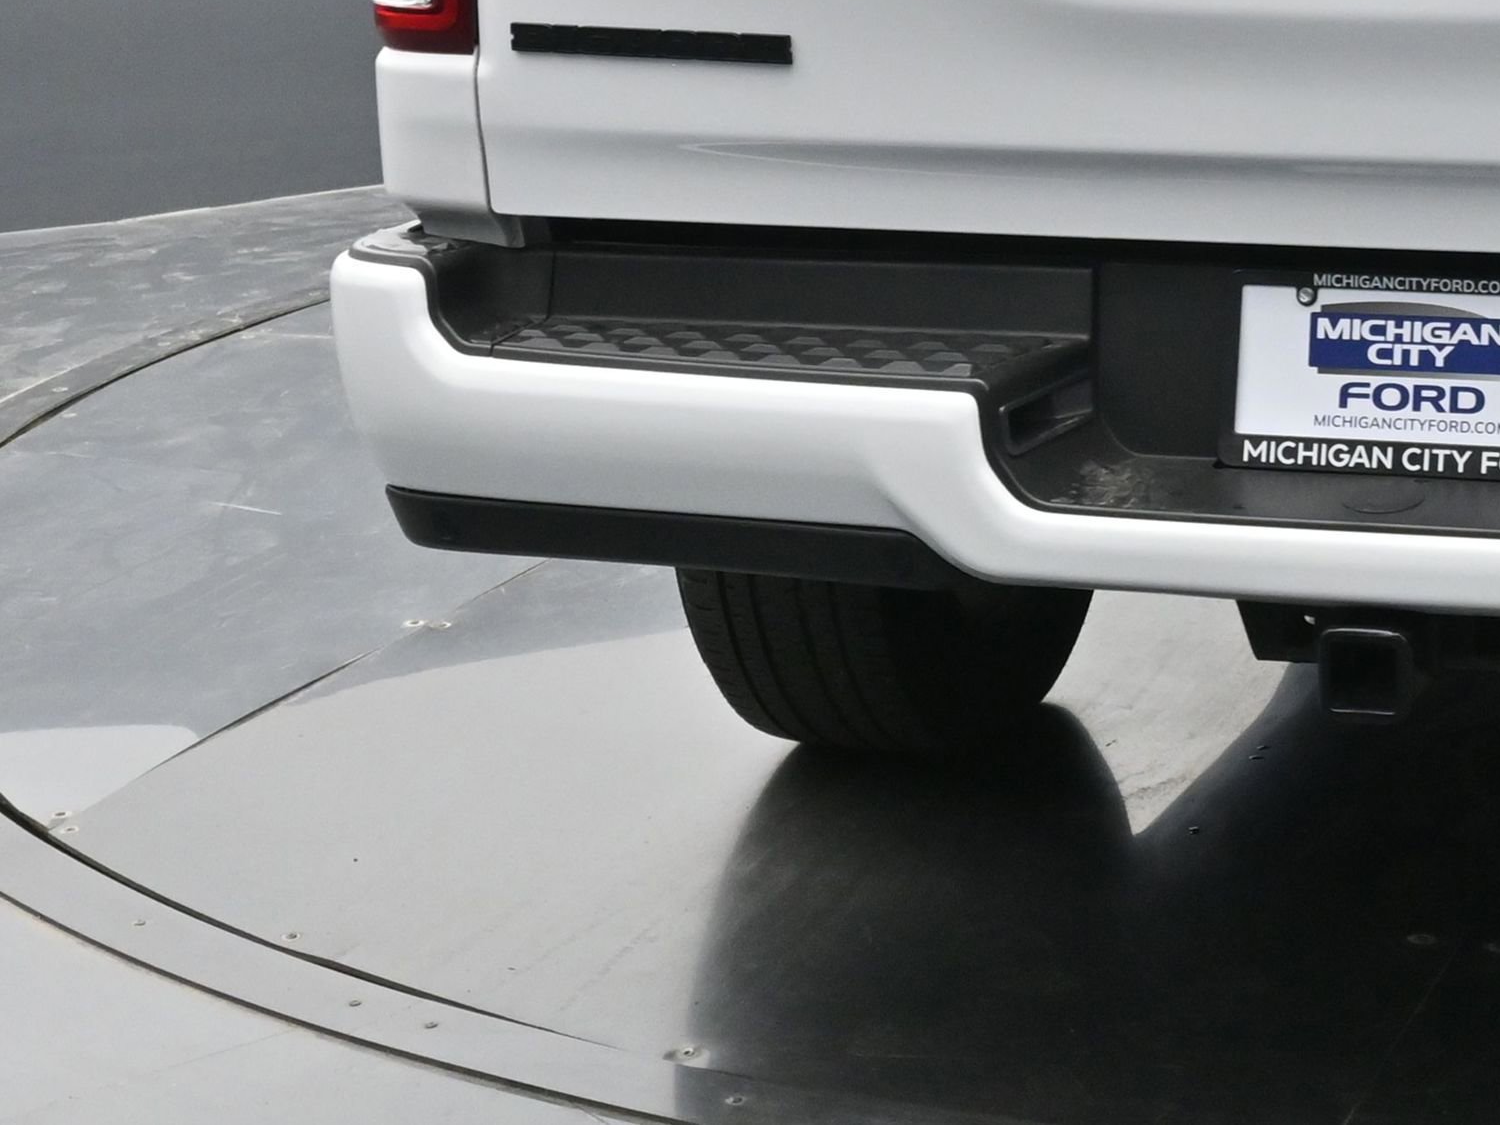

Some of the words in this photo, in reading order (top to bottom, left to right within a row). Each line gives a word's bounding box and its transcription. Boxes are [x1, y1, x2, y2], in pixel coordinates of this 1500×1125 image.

[1366, 343, 1455, 368] CITY
[1338, 382, 1485, 414] FORD
[1242, 439, 1393, 470] MICHIGAN
[1401, 448, 1472, 474] CITY
